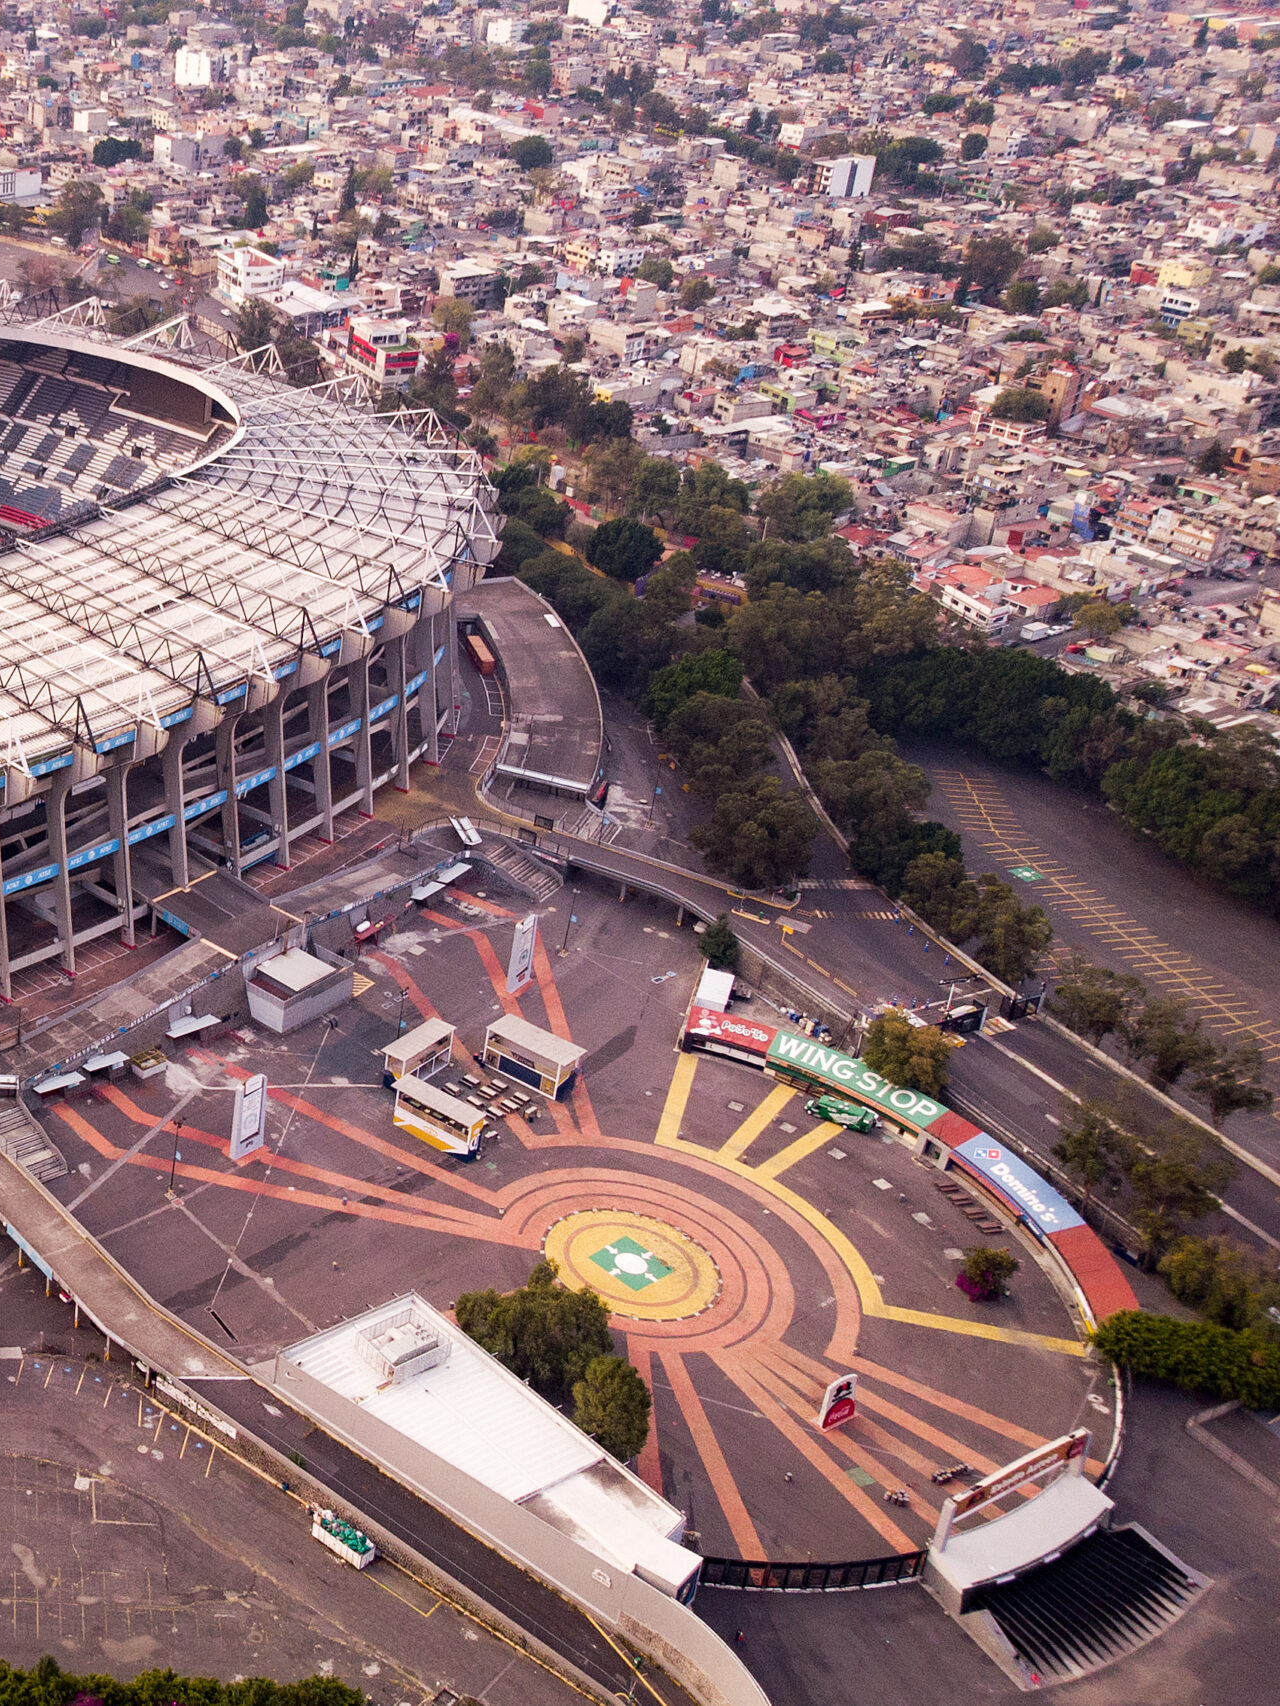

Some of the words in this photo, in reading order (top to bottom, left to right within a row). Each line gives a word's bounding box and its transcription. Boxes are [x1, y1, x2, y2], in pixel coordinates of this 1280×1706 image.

[6, 881, 20, 890] AT&T
[38, 870, 52, 878] AT&T
[989, 1162, 1058, 1222] Domino's
